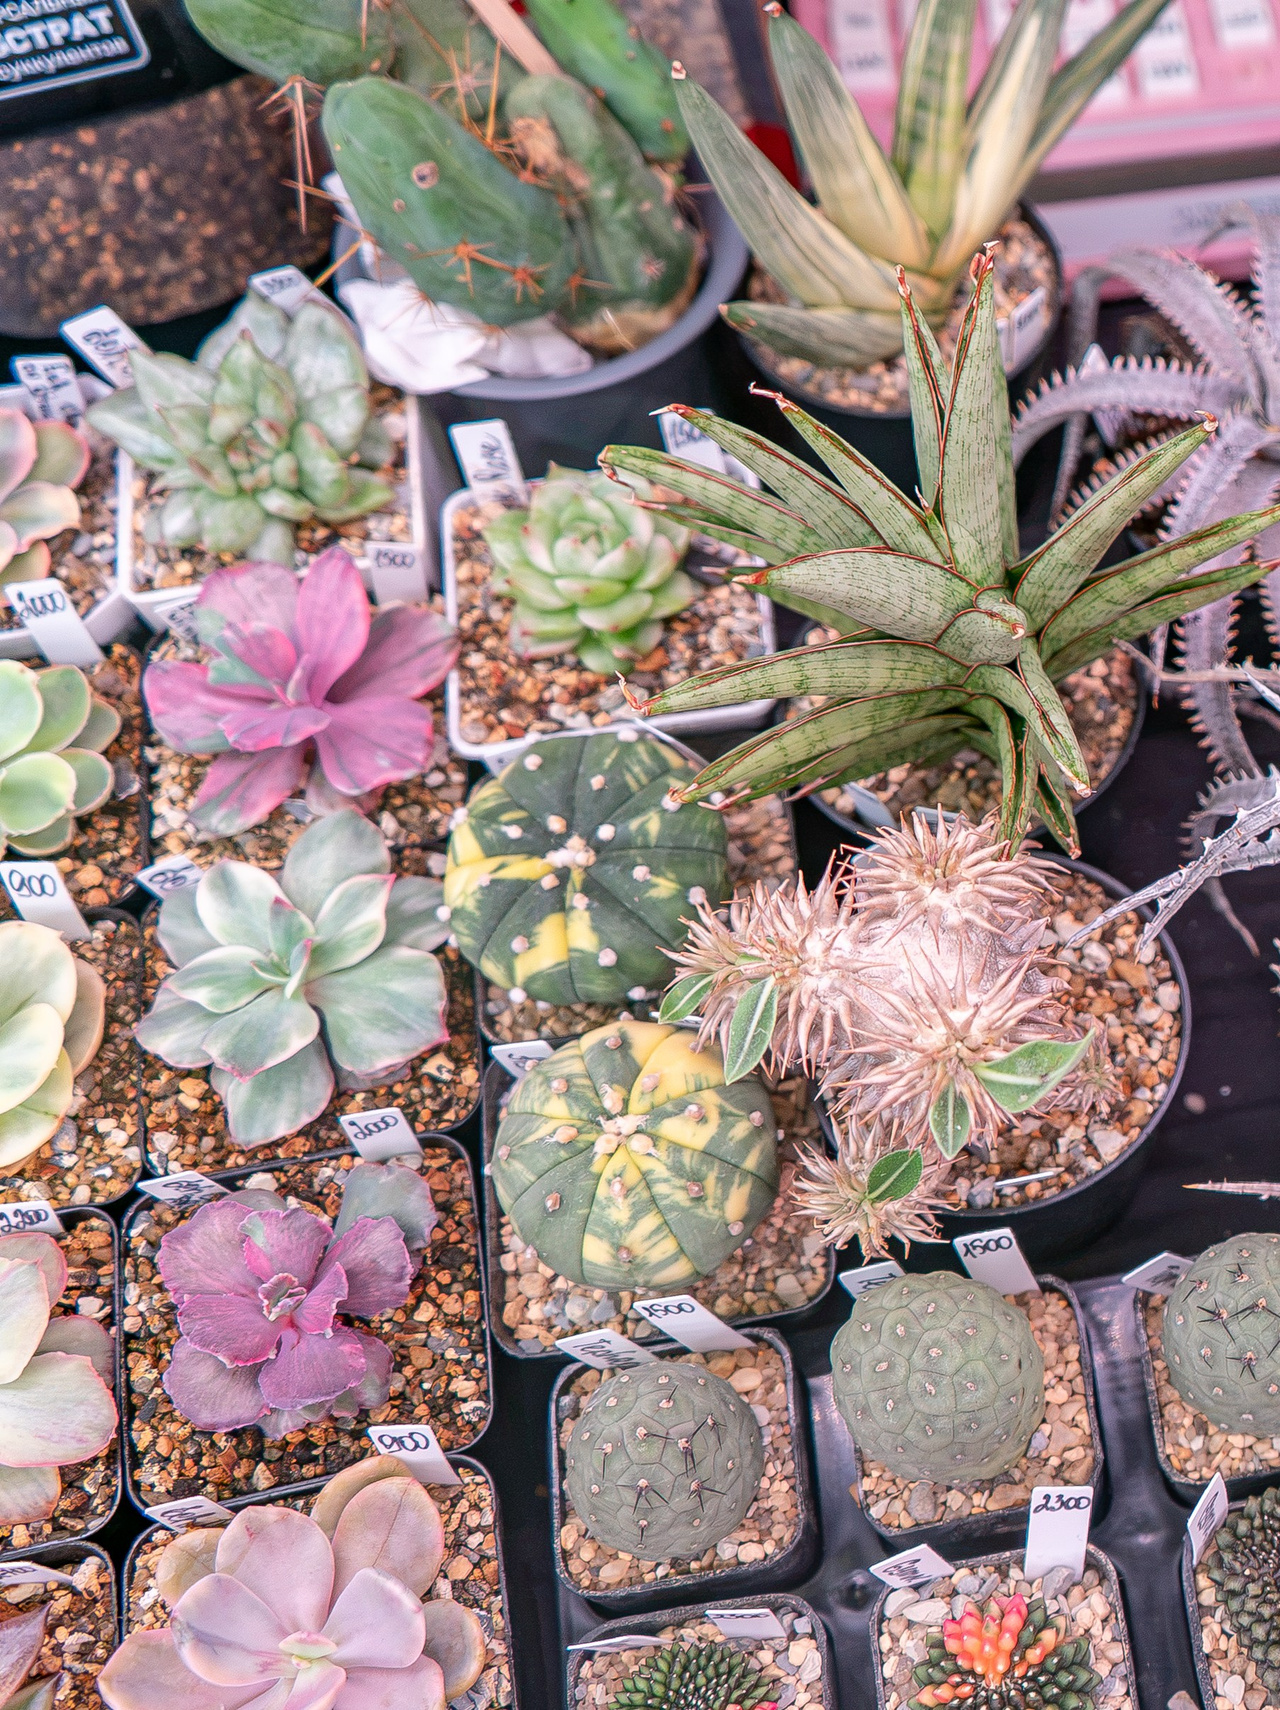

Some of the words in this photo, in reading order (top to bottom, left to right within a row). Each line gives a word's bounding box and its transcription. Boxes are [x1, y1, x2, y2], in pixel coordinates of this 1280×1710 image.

[9, 869, 57, 897] 900
[963, 1235, 1013, 1259] 1500
[641, 1302, 695, 1320] 1500
[378, 1431, 430, 1453] 900
[1033, 1493, 1092, 1514] 2300
